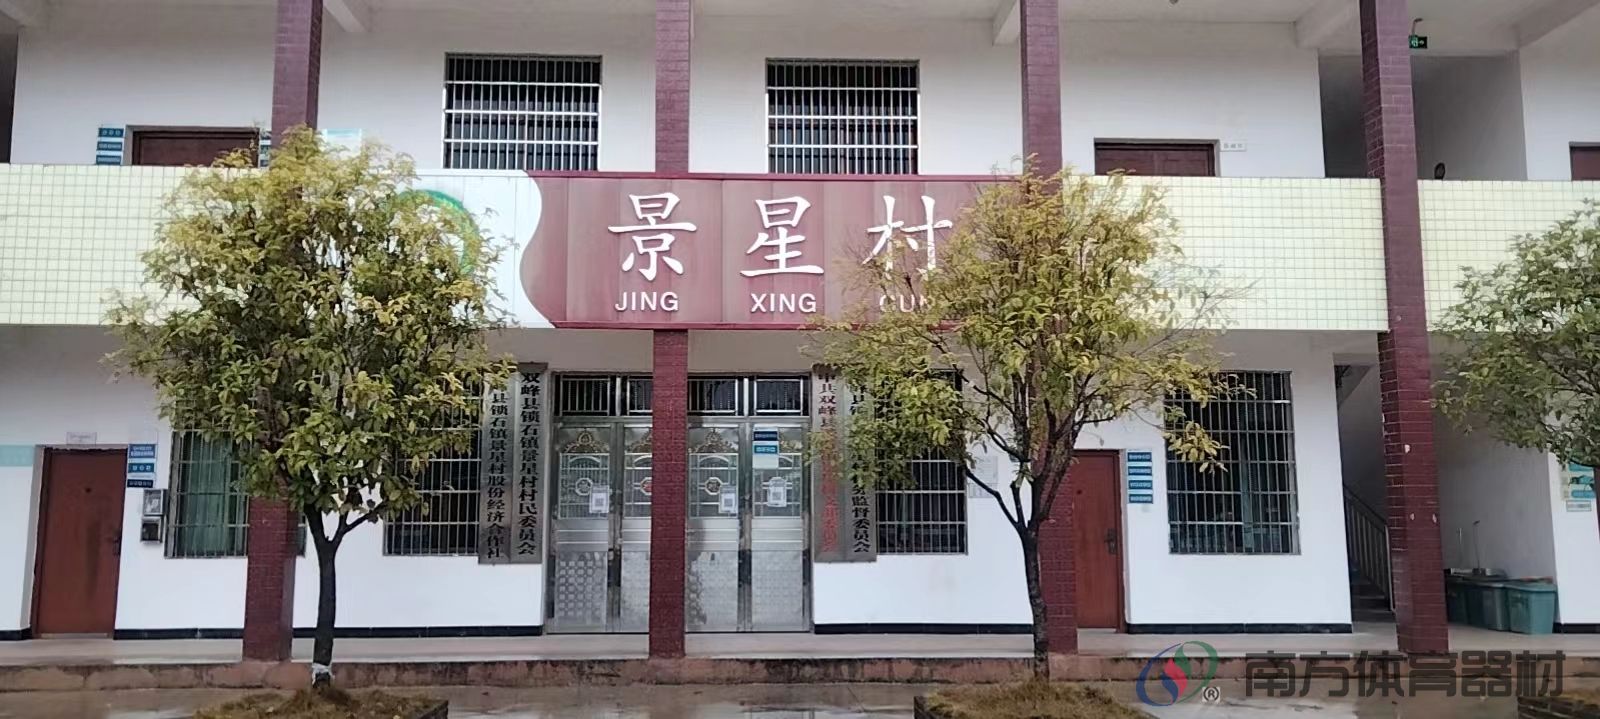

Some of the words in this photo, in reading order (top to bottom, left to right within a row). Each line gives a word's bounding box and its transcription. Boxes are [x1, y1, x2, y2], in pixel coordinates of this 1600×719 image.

[607, 191, 953, 281] 景星村
[614, 291, 680, 312] JING
[750, 292, 818, 313] XING
